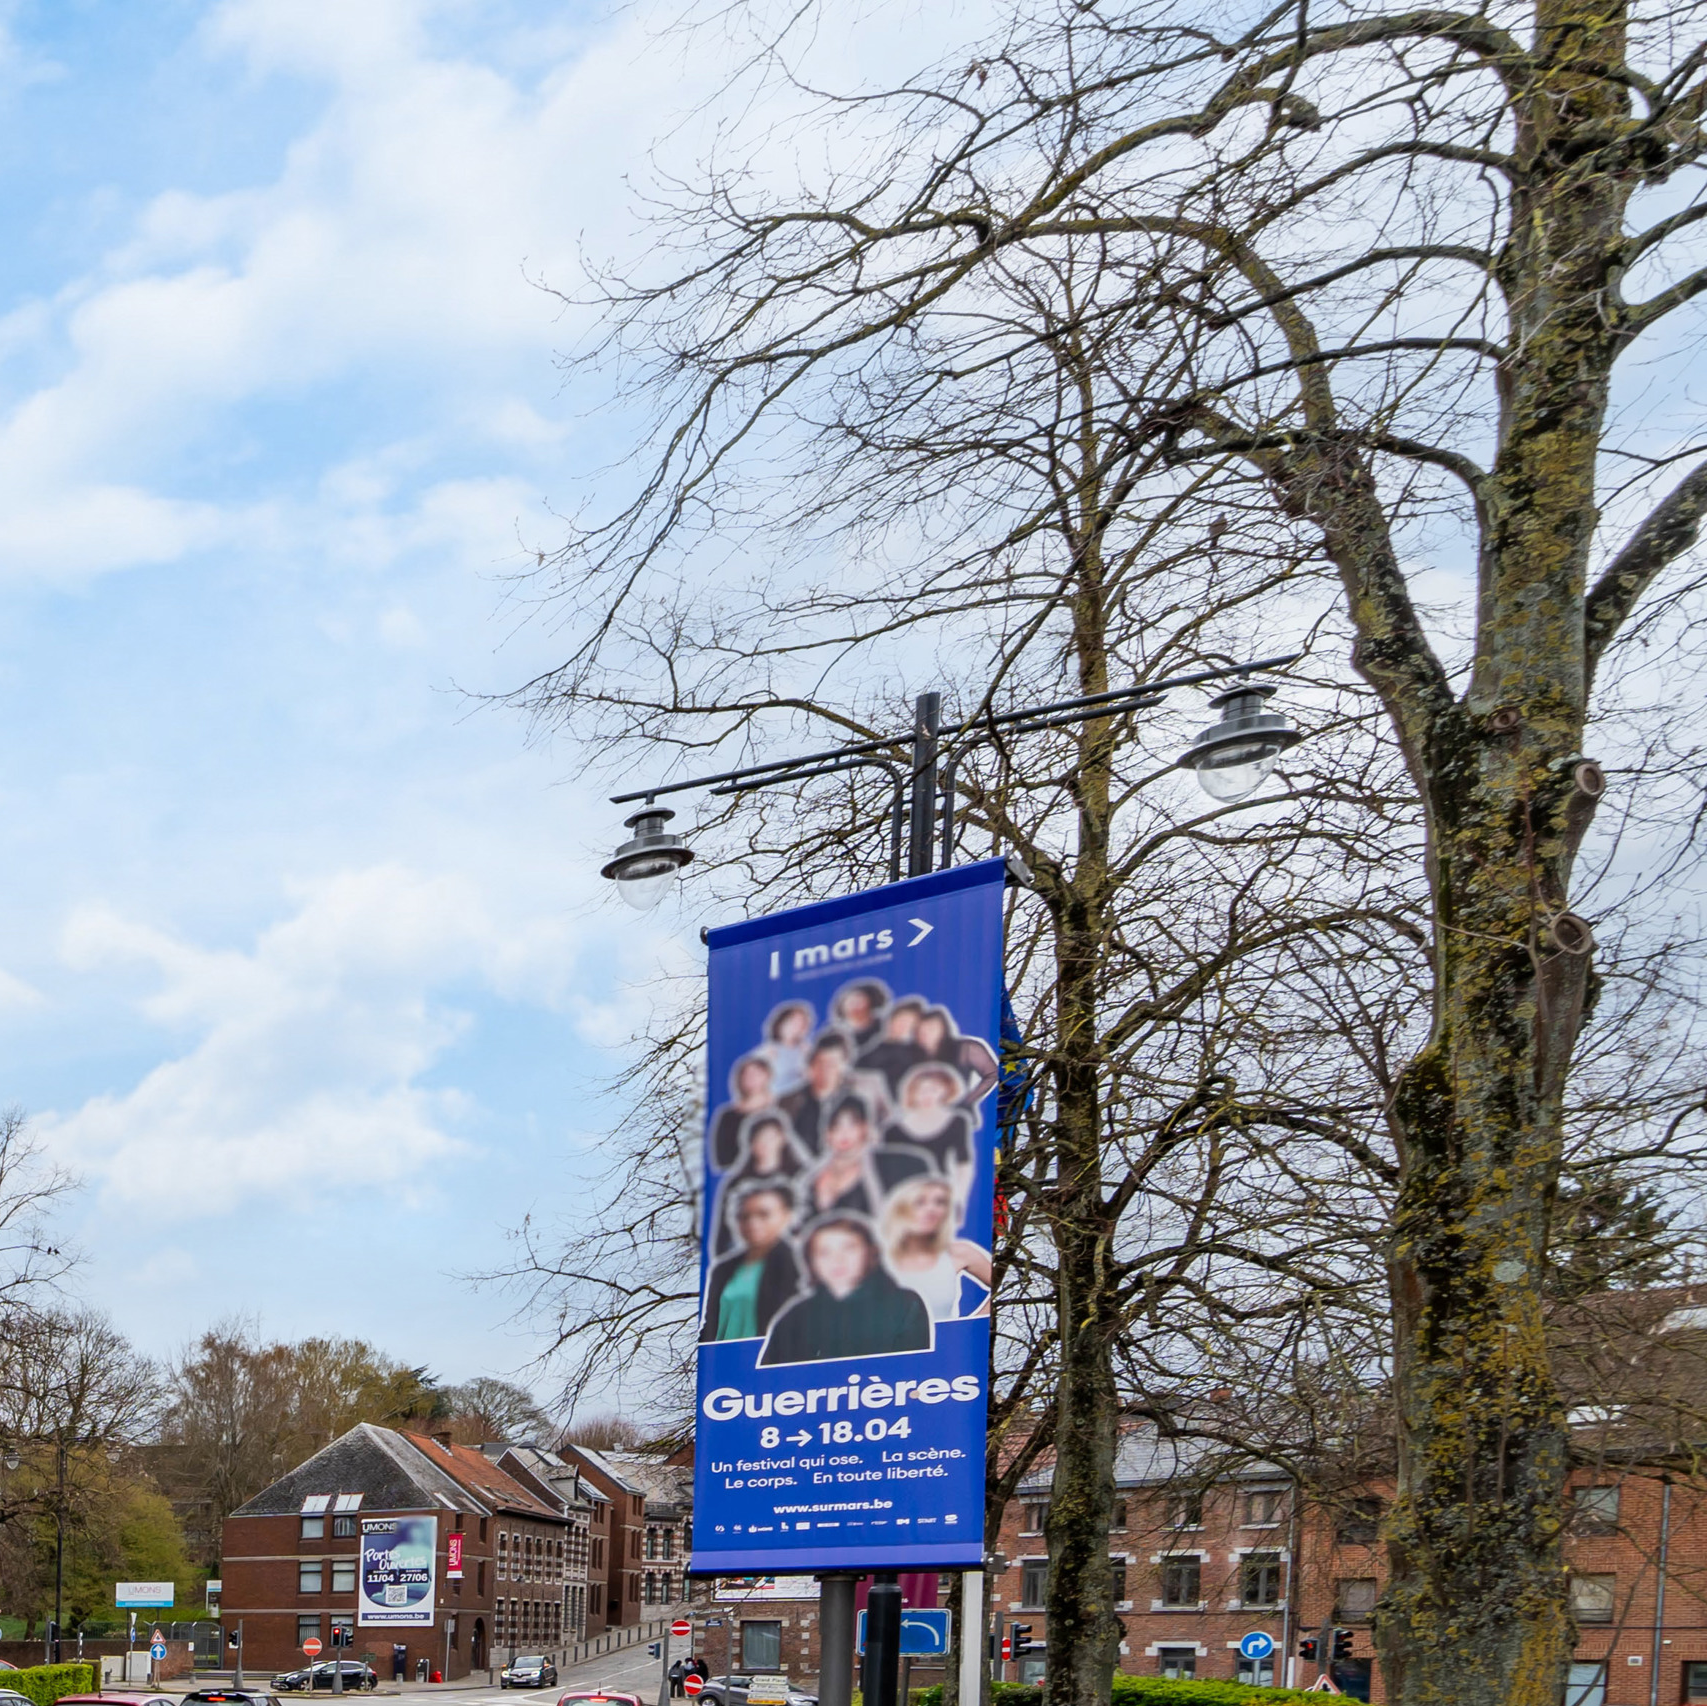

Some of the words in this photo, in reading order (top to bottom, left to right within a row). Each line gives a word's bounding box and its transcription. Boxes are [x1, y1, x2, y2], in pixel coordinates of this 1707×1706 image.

[794, 929, 894, 970] mars
[702, 1374, 981, 1421] Guerrières
[760, 1427, 780, 1449] 8
[818, 1416, 912, 1444] 18.04
[711, 1461, 733, 1473] Un
[736, 1457, 795, 1472] festival
[799, 1454, 825, 1470] qui
[829, 1453, 864, 1465] ose.
[882, 1450, 903, 1463] La
[907, 1448, 967, 1462] scène.
[725, 1477, 744, 1489] Le
[747, 1474, 798, 1490] corps.
[813, 1472, 833, 1484] En
[837, 1469, 883, 1483] toute
[887, 1464, 949, 1480] liberté.
[773, 1499, 893, 1514] www.surmars.be
[364, 1548, 401, 1562] Portes
[379, 1555, 427, 1570] Ouvertes
[449, 1539, 458, 1566] UMONS
[367, 1574, 395, 1583] 11/04
[400, 1573, 428, 1582] 27/06
[128, 1585, 162, 1595] UMONS
